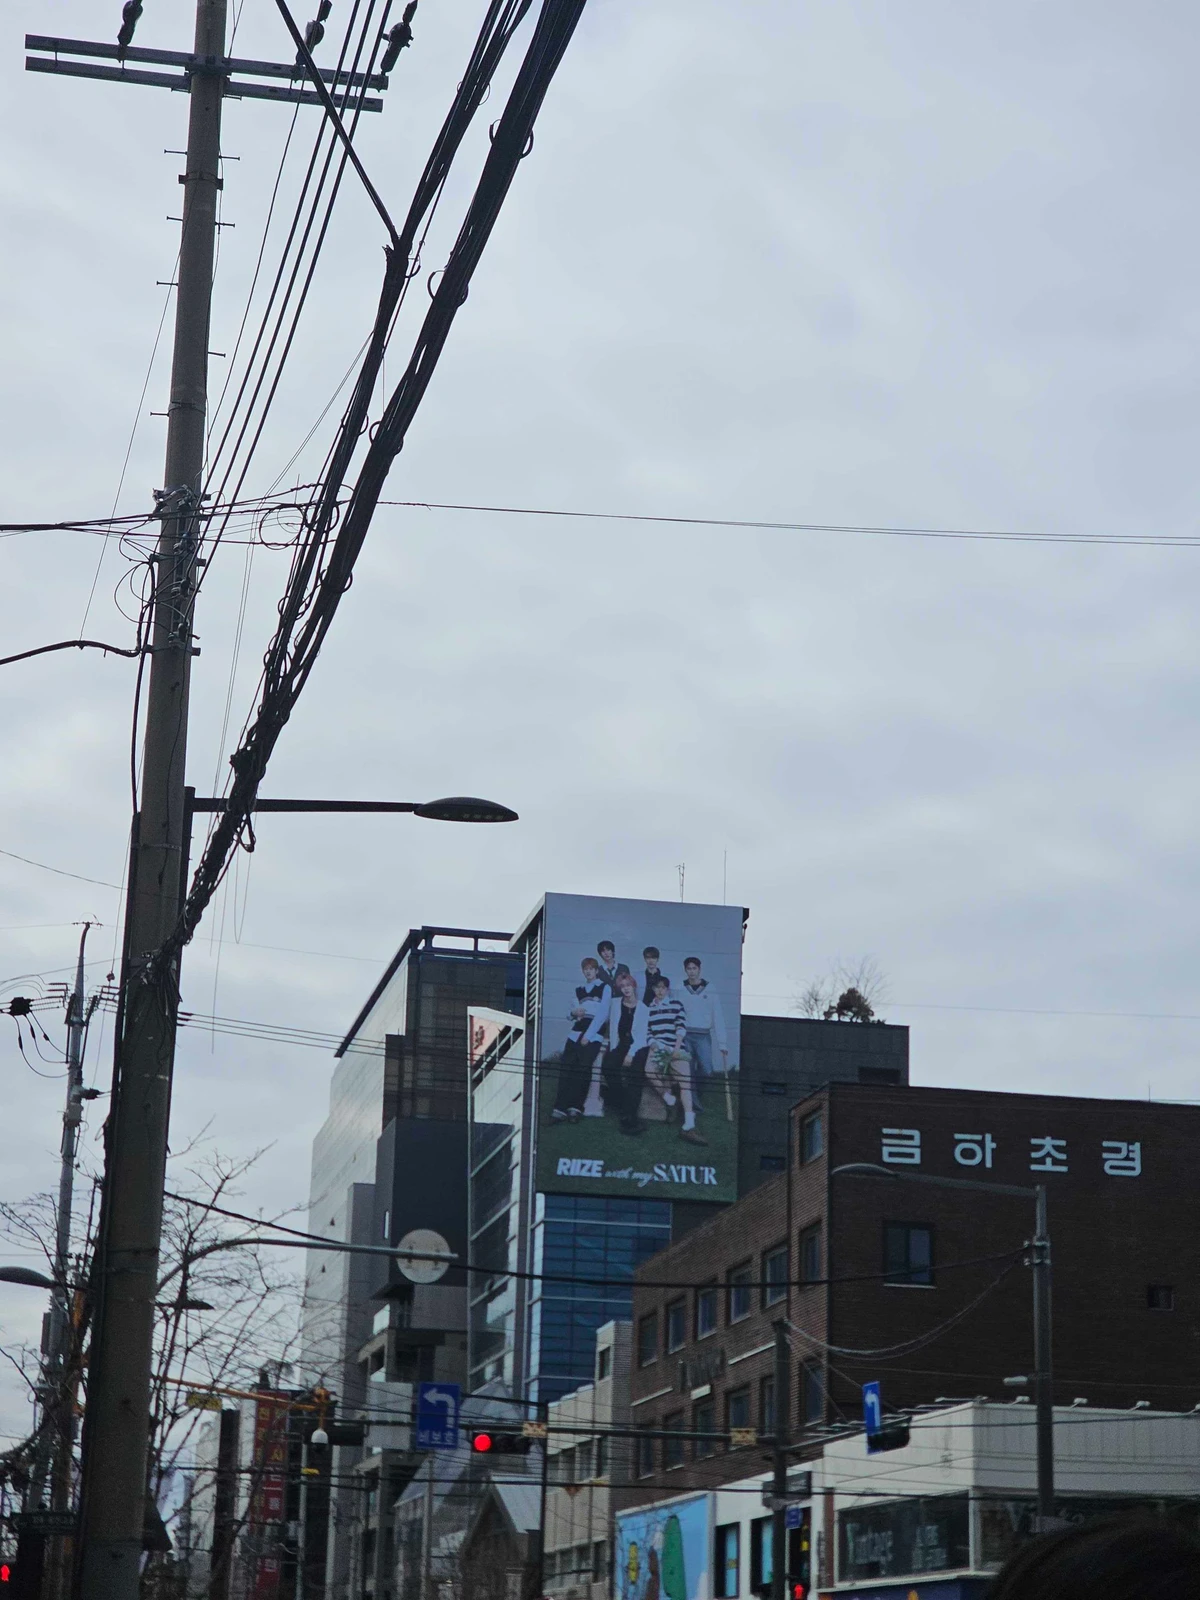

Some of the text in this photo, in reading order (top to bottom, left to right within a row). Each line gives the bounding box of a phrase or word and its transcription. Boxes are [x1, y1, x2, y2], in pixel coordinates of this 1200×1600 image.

[556, 1157, 604, 1178] RIIZE
[631, 1172, 654, 1188] my
[653, 1163, 718, 1186] SATUR
[418, 1429, 455, 1445] 비보호
